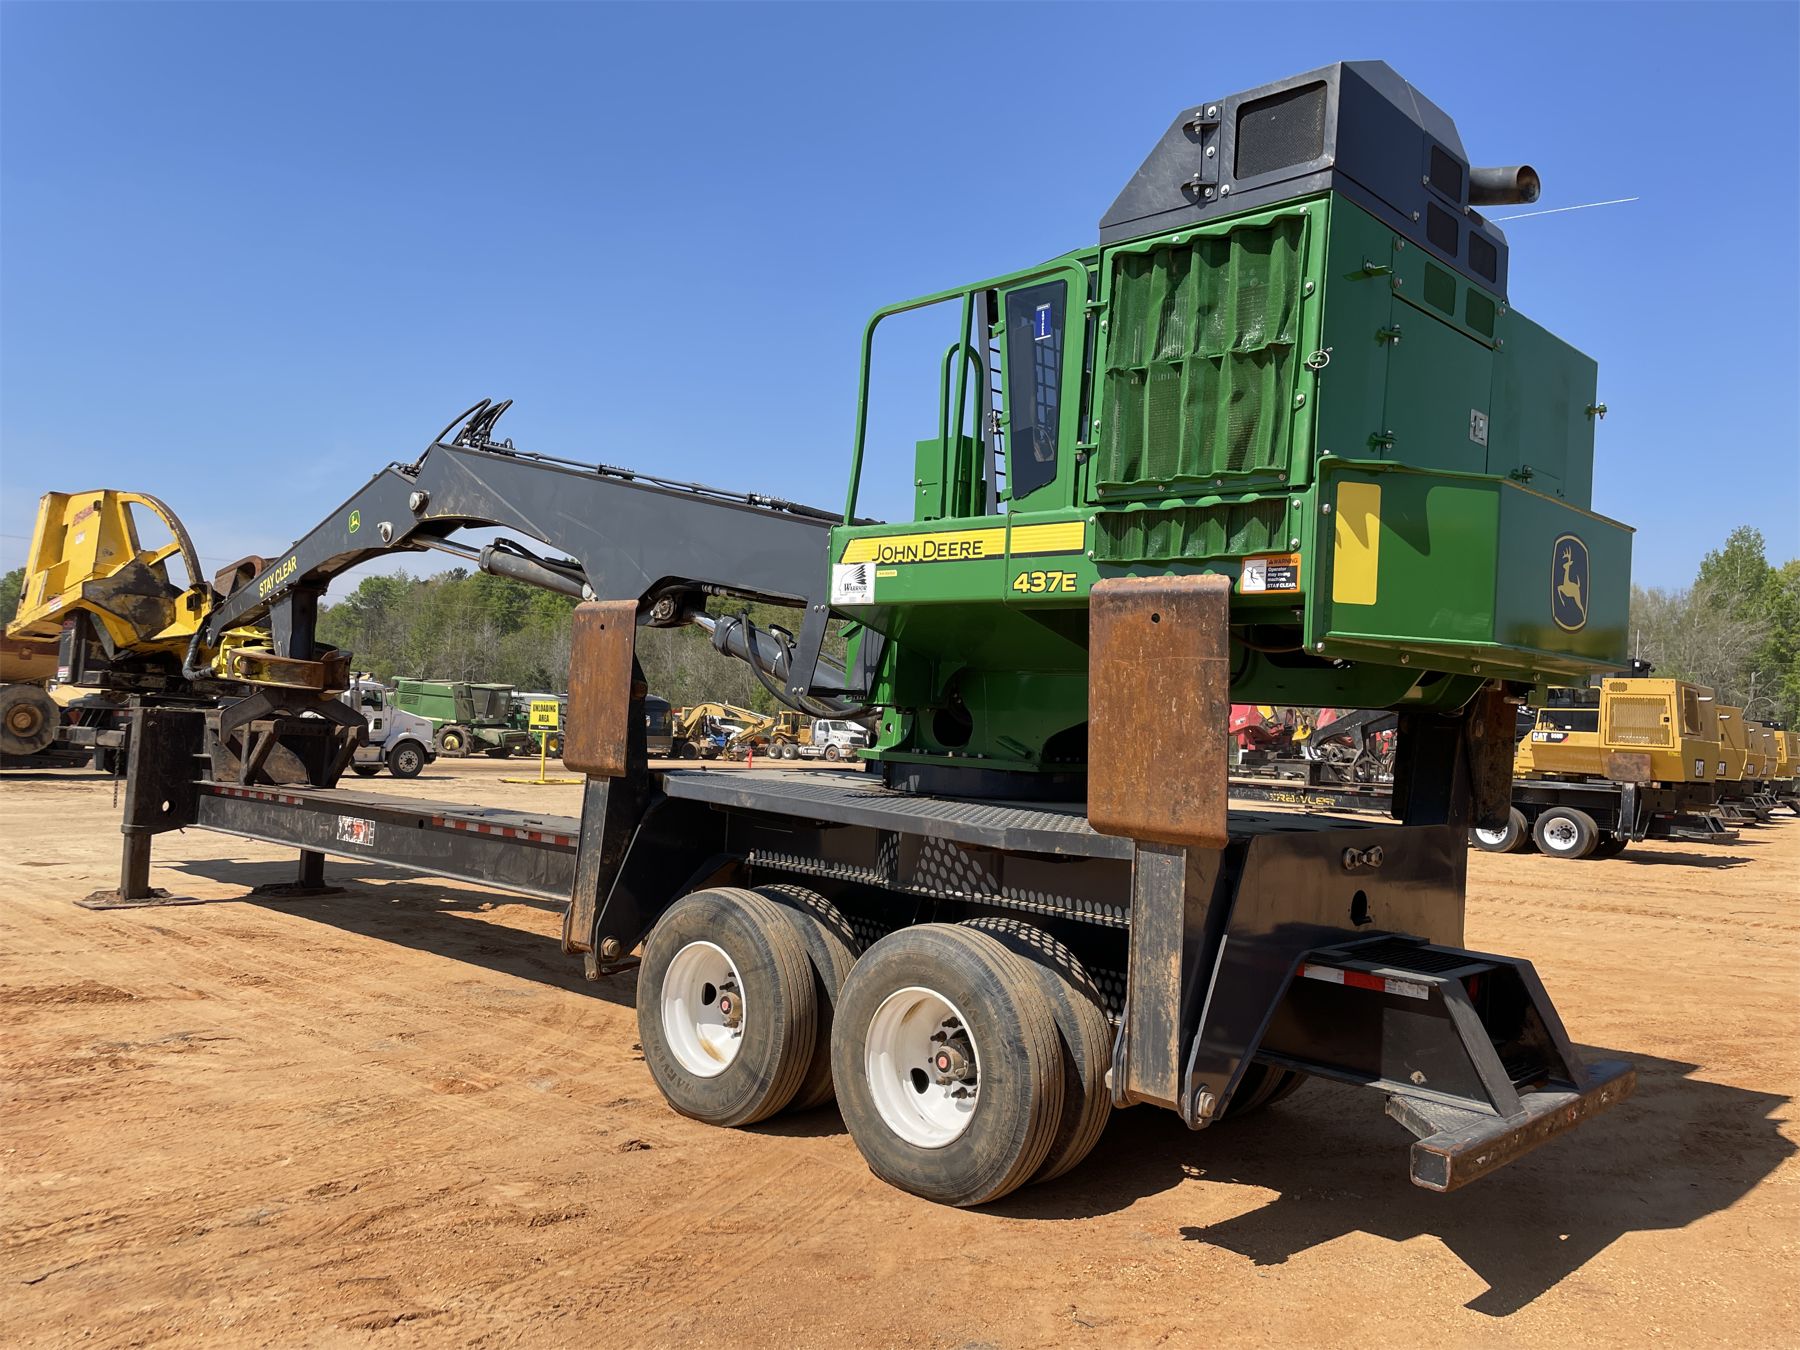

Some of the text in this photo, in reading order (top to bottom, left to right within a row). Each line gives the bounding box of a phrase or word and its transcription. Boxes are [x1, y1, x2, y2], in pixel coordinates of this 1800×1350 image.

[871, 540, 984, 562] JOHN DEERE
[259, 556, 297, 598] STAY CLEAR
[1012, 570, 1078, 593] 437E
[533, 704, 556, 712] UNLOADING
[1532, 732, 1548, 741] CAT
